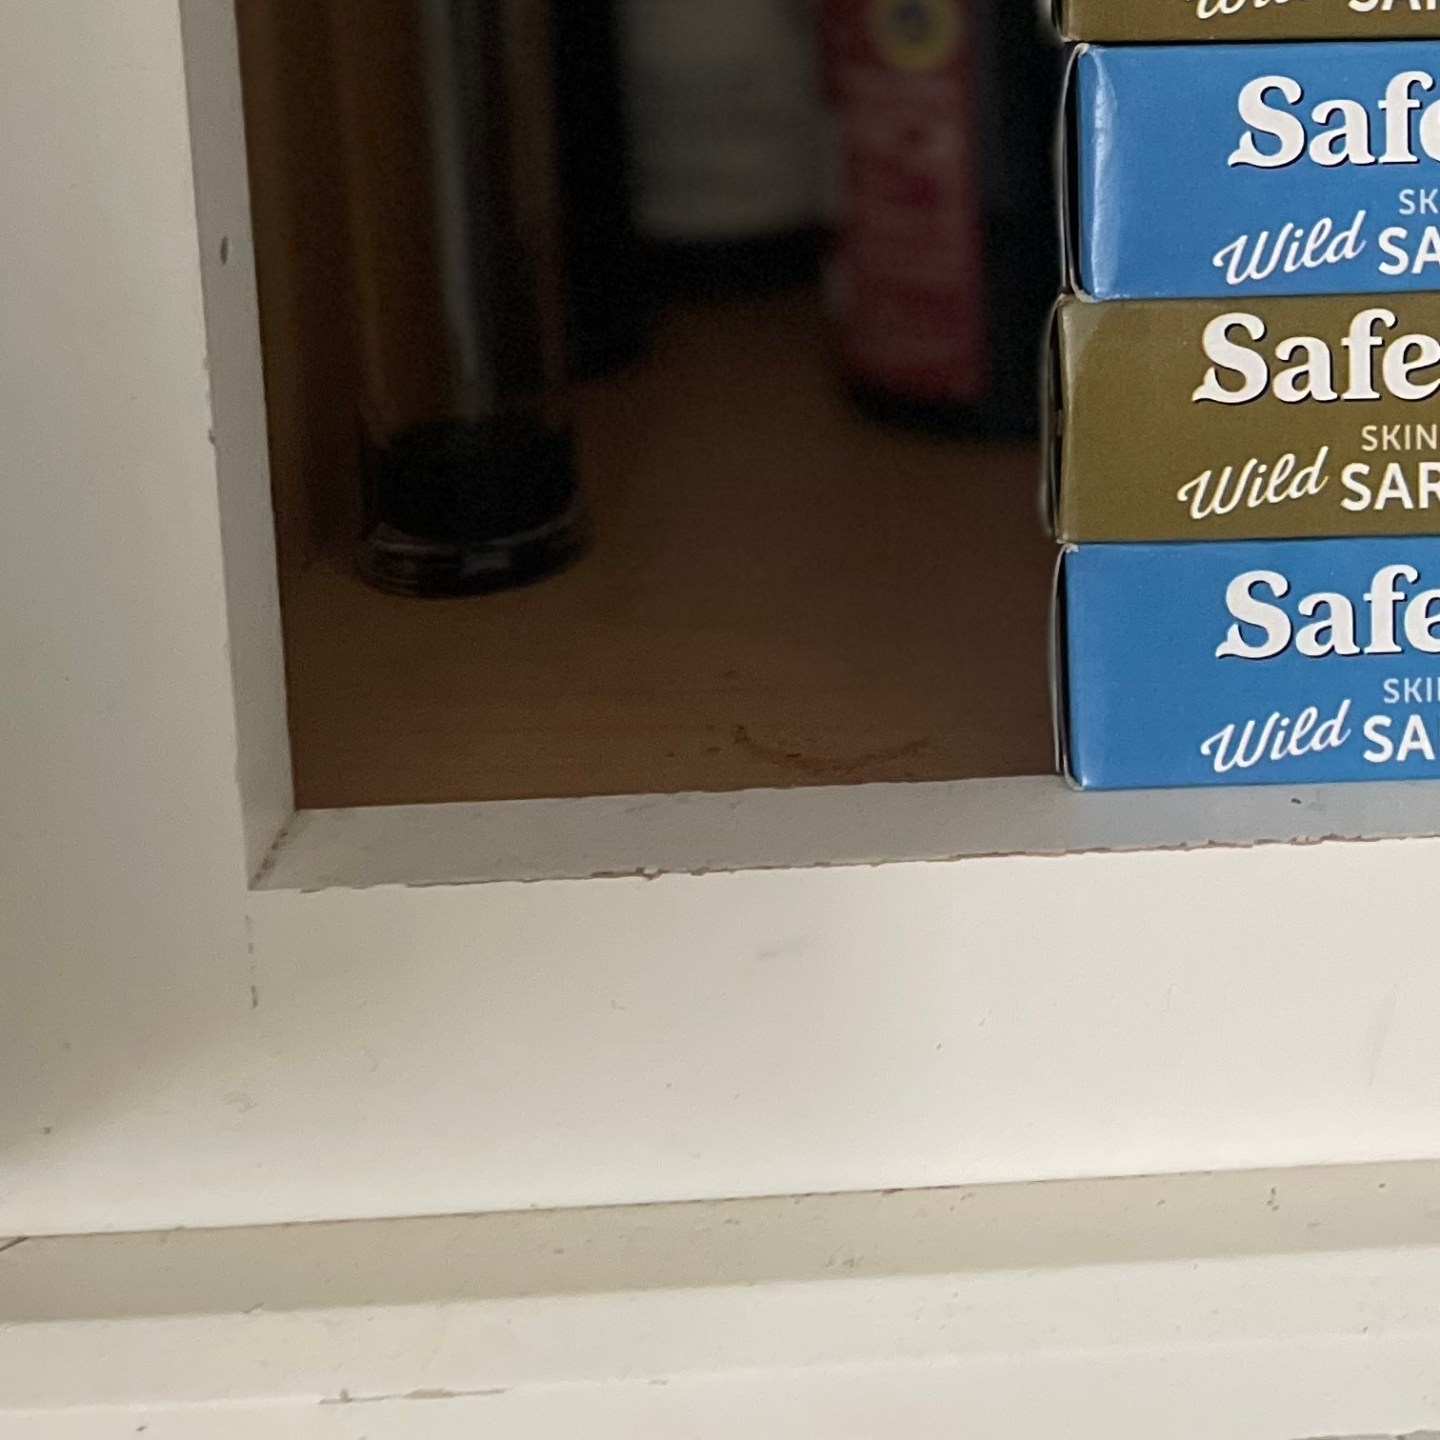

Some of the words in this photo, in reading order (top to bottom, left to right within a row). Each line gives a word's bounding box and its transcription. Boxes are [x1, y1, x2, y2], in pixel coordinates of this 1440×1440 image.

[1212, 209, 1367, 285] Wild
[1177, 445, 1329, 519] Wild
[1200, 698, 1351, 773] Wild
